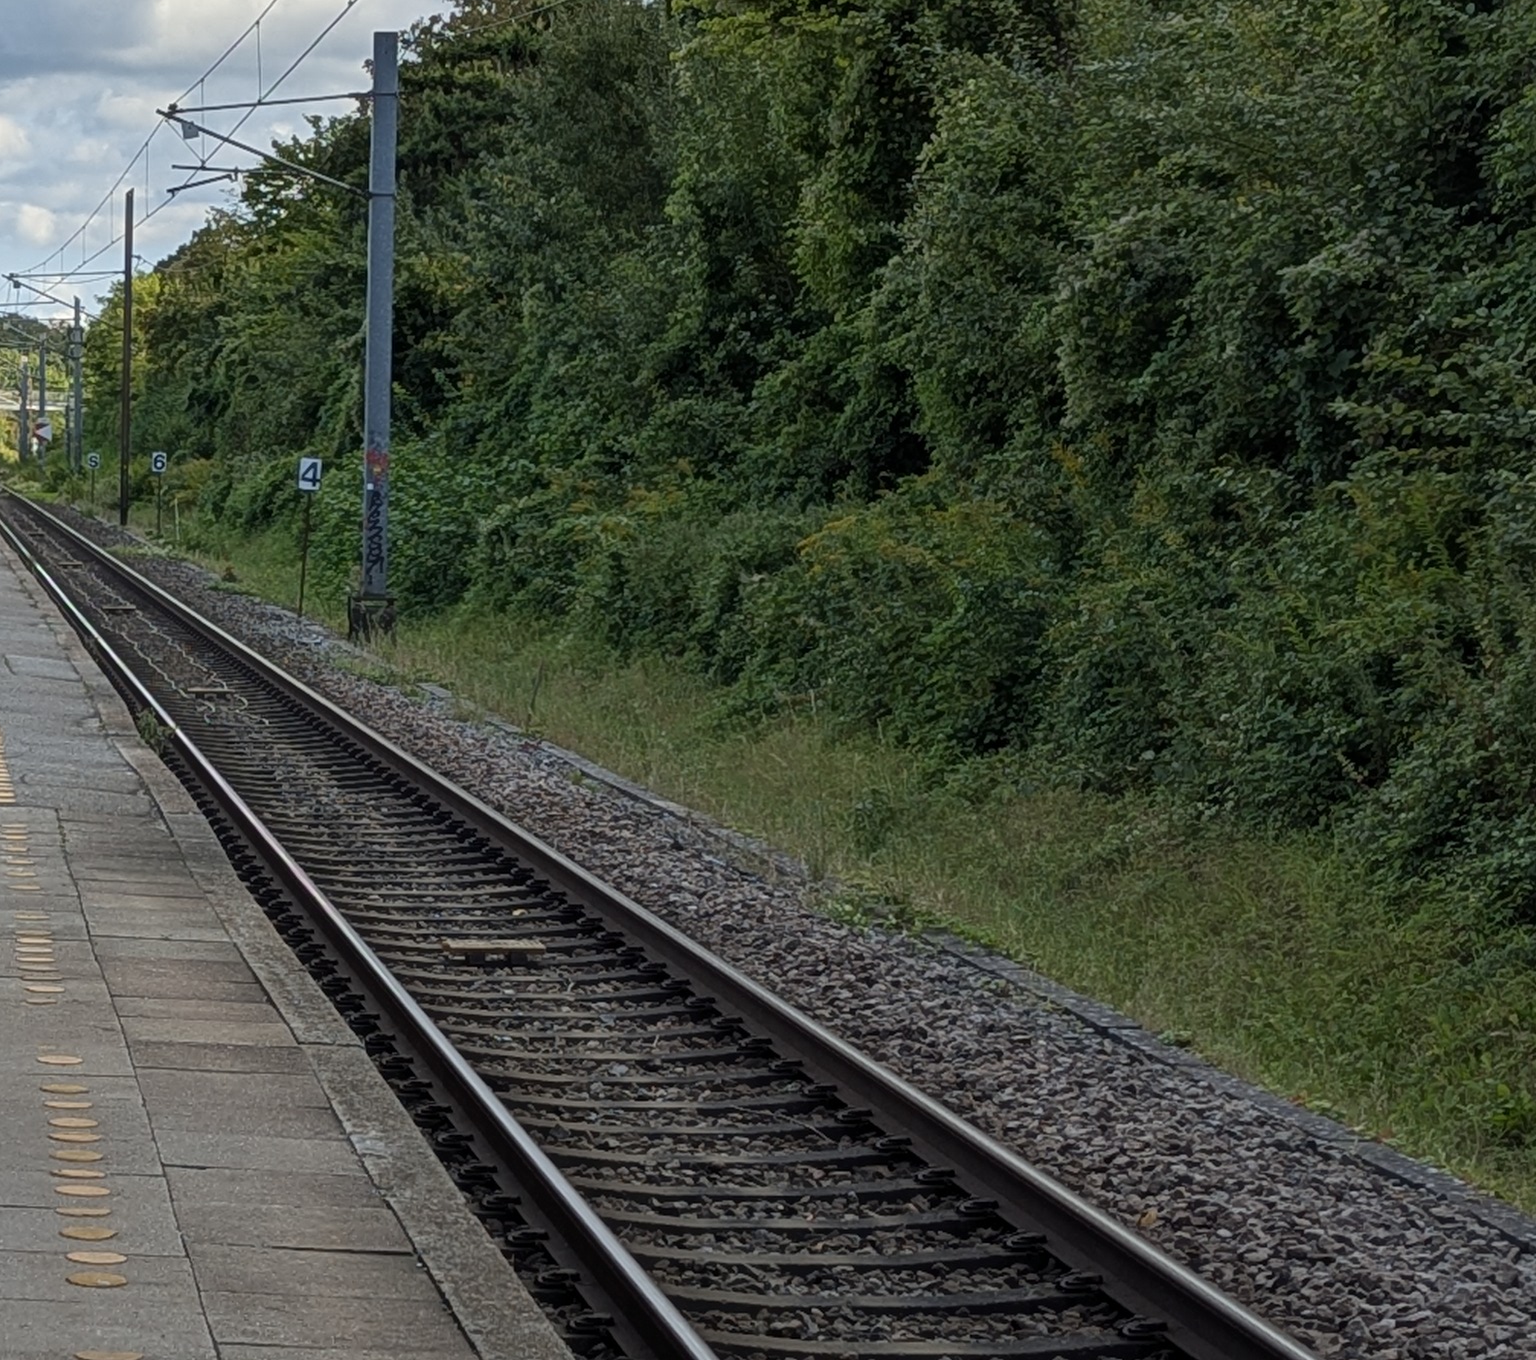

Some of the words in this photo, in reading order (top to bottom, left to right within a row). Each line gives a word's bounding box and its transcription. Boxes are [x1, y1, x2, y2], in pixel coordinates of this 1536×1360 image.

[89, 455, 99, 468] S
[153, 454, 166, 471] 6
[301, 461, 322, 487] 4
